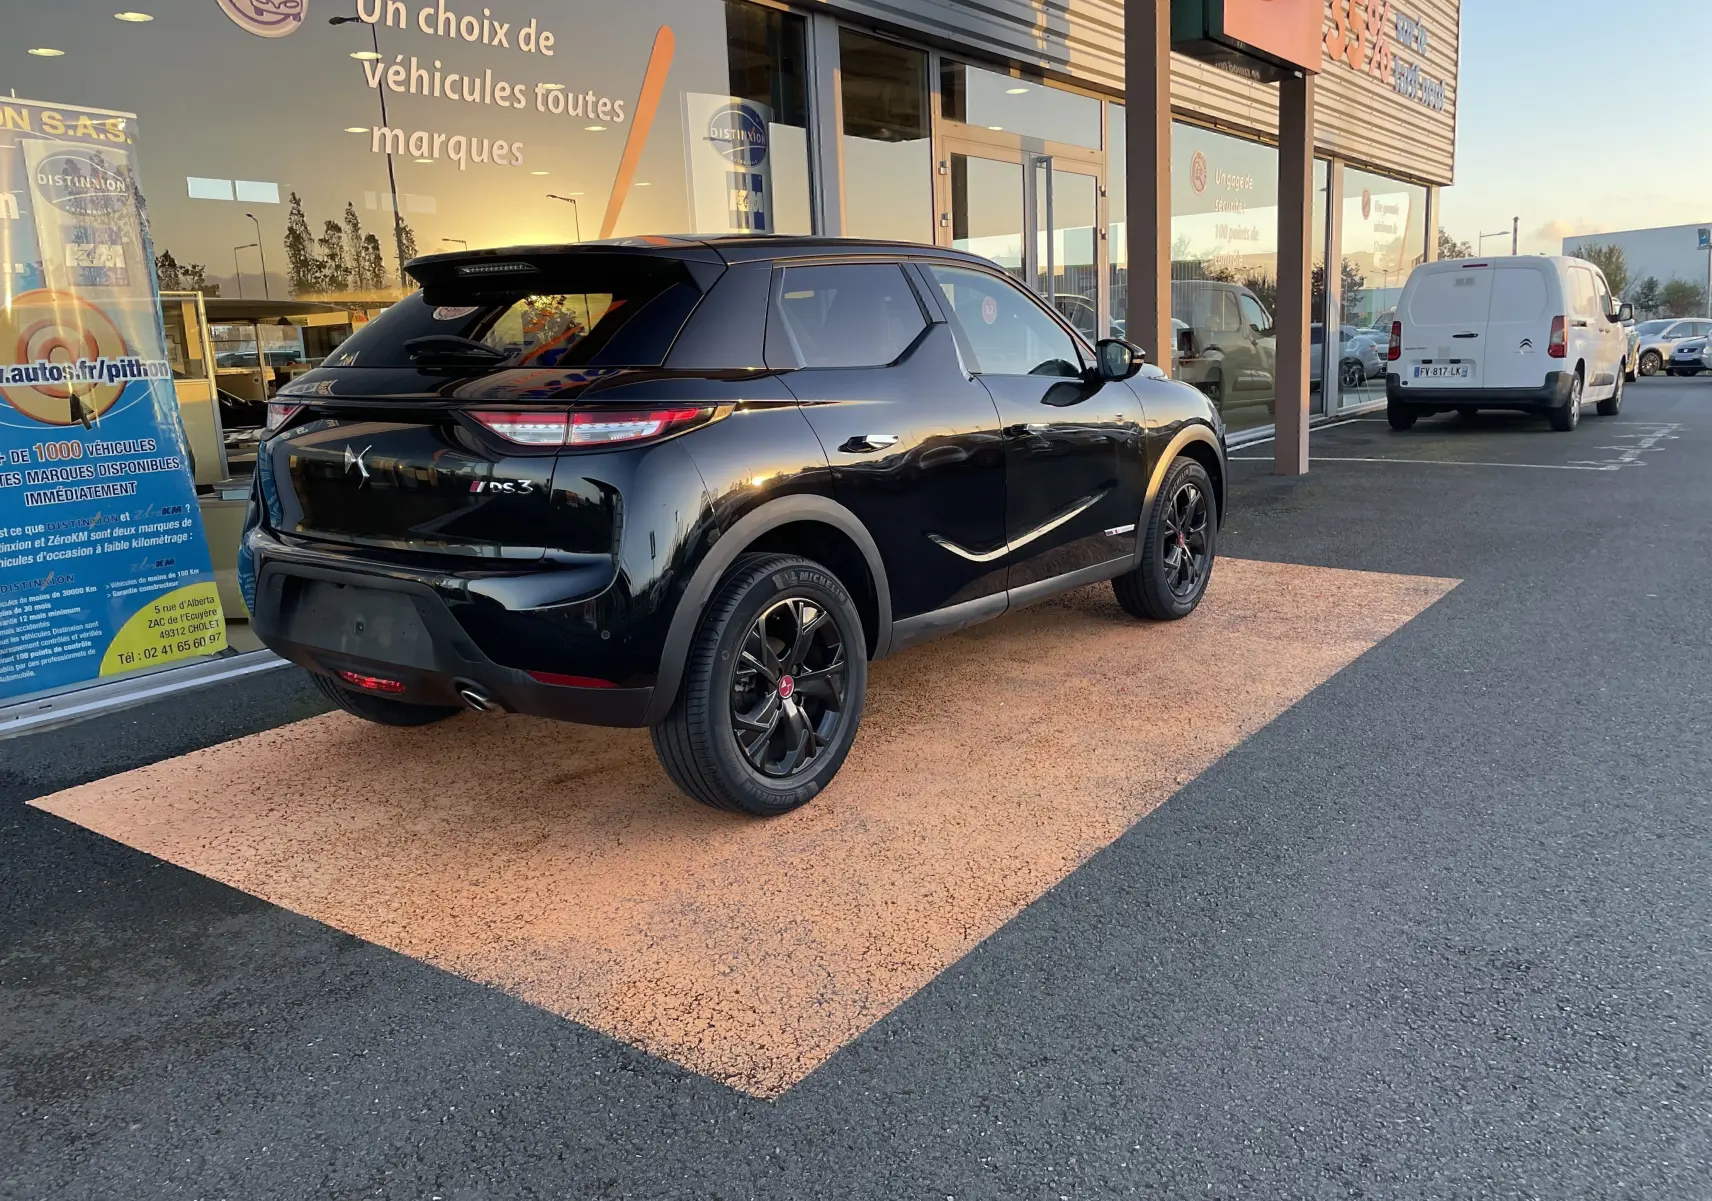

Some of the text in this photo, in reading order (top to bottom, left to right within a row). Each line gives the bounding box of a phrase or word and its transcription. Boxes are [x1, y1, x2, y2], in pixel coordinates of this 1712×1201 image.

[356, 0, 556, 57] Un choix de
[361, 54, 626, 124] véhicules toutes
[370, 124, 525, 171] marques
[1215, 167, 1226, 185] Un
[1226, 173, 1244, 192] gage
[0, 356, 170, 384] .autos.fr/pithon
[10, 449, 30, 464] DE
[33, 440, 82, 462] 1000
[85, 439, 156, 456] VÉHICULES
[26, 464, 95, 485] MARQUES
[98, 457, 181, 477] DISPONIBLES
[24, 481, 137, 507] IMMÉDIATEMENT
[10, 526, 22, 536] ce
[25, 524, 45, 536] que
[120, 511, 131, 522] et
[185, 503, 191, 513] ?
[34, 537, 45, 548] et
[47, 530, 88, 546] ZéroKM
[90, 528, 111, 541] sont
[113, 526, 136, 538] deux
[138, 520, 180, 534] marques
[181, 517, 192, 528] de
[36, 547, 93, 563] d'occasion
[95, 543, 102, 554] à
[104, 540, 130, 553] faible
[138, 580, 180, 593] constructeur
[147, 573, 168, 582] moins
[168, 571, 177, 579] de
[189, 568, 199, 576] Km
[799, 571, 847, 603] MICHELIN
[14, 606, 22, 614] de
[24, 605, 32, 613] 30
[34, 602, 52, 610] mois
[29, 592, 50, 603] moins
[52, 591, 60, 599] de
[154, 596, 215, 615] 5 rue d'Alberta
[19, 615, 28, 623] 12
[29, 611, 47, 621] mois
[48, 606, 81, 618] minimum
[148, 608, 217, 629] ZAC de l'Ecuyère
[159, 619, 220, 640] 49312 CHOLET
[30, 647, 53, 659] points
[63, 640, 92, 651] contrôle
[118, 651, 135, 665] Tél
[143, 647, 159, 660] 02
[161, 644, 174, 656] 41
[177, 640, 191, 653] 65
[193, 636, 206, 649] 60
[209, 631, 222, 644] 97
